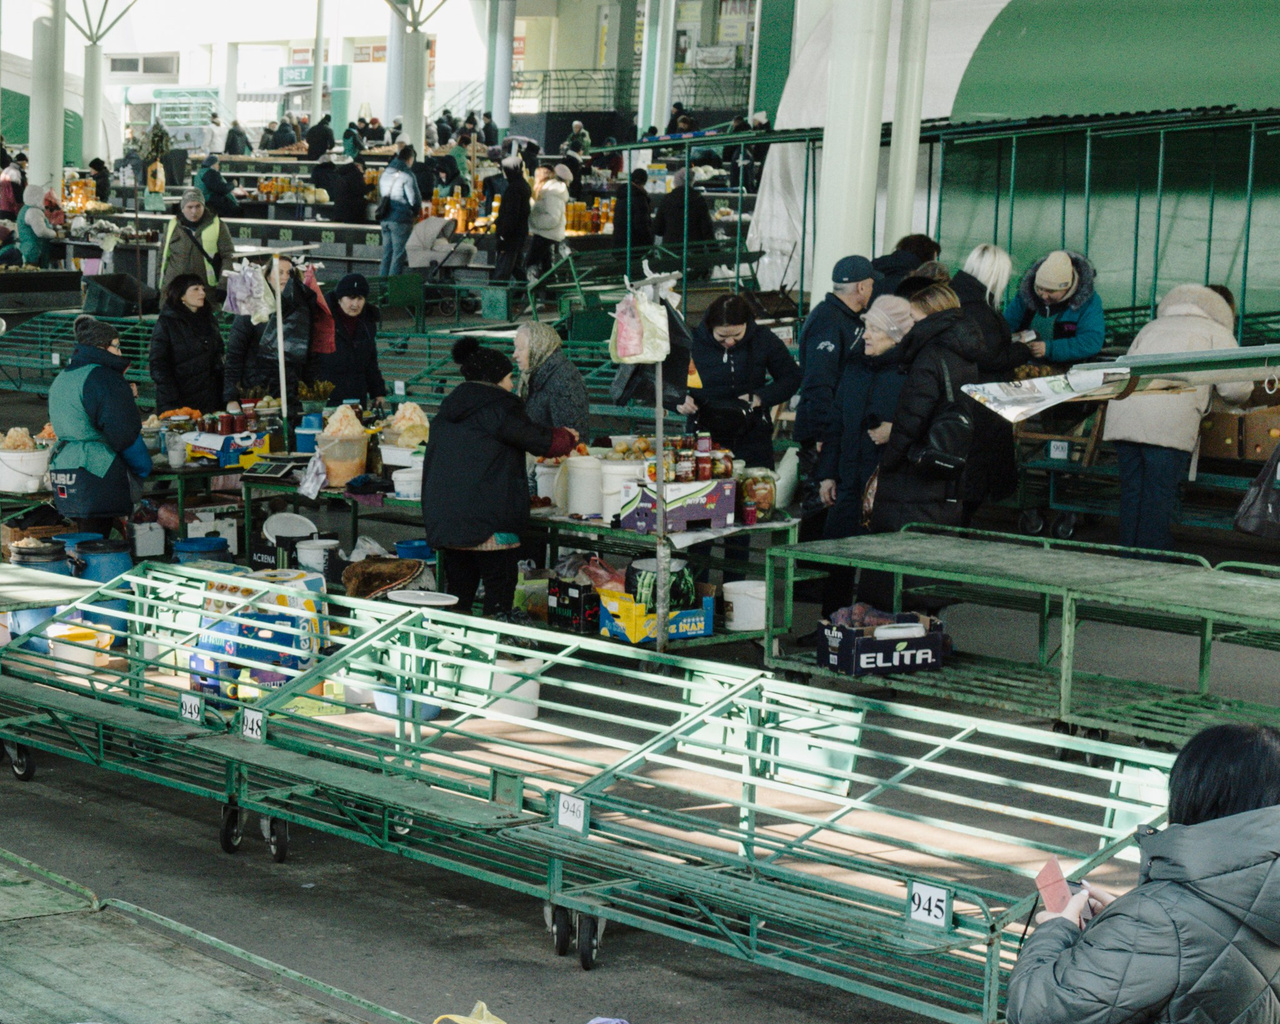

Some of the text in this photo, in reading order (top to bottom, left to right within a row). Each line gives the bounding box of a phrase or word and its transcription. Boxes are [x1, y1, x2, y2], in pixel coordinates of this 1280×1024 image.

[860, 648, 933, 669] ELITA
[182, 701, 200, 721] 949
[242, 715, 262, 737] 948
[562, 799, 582, 819] 946
[911, 892, 945, 919] 945
